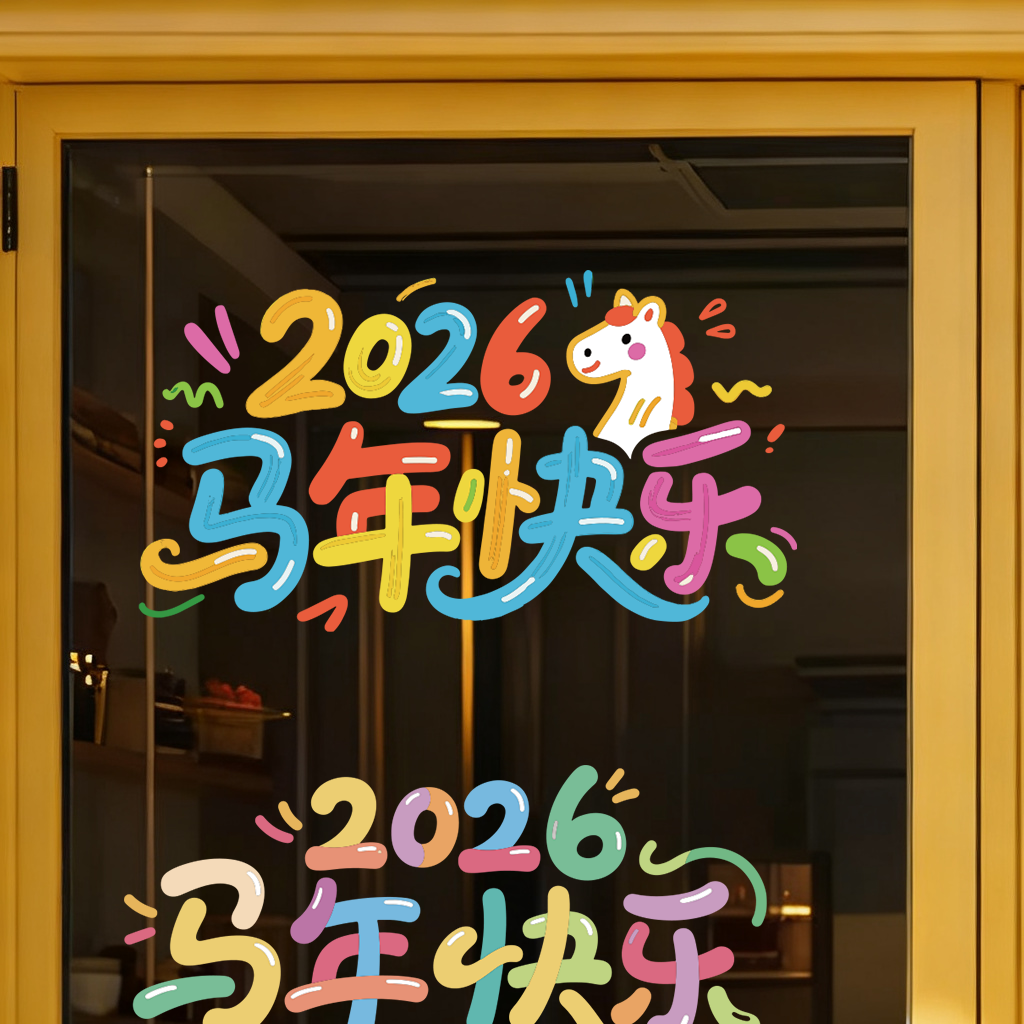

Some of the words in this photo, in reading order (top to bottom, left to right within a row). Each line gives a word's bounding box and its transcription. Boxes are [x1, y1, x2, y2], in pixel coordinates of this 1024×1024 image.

[246, 288, 551, 418] 2026
[140, 420, 788, 622] 马年快乐
[304, 764, 627, 881] 2026
